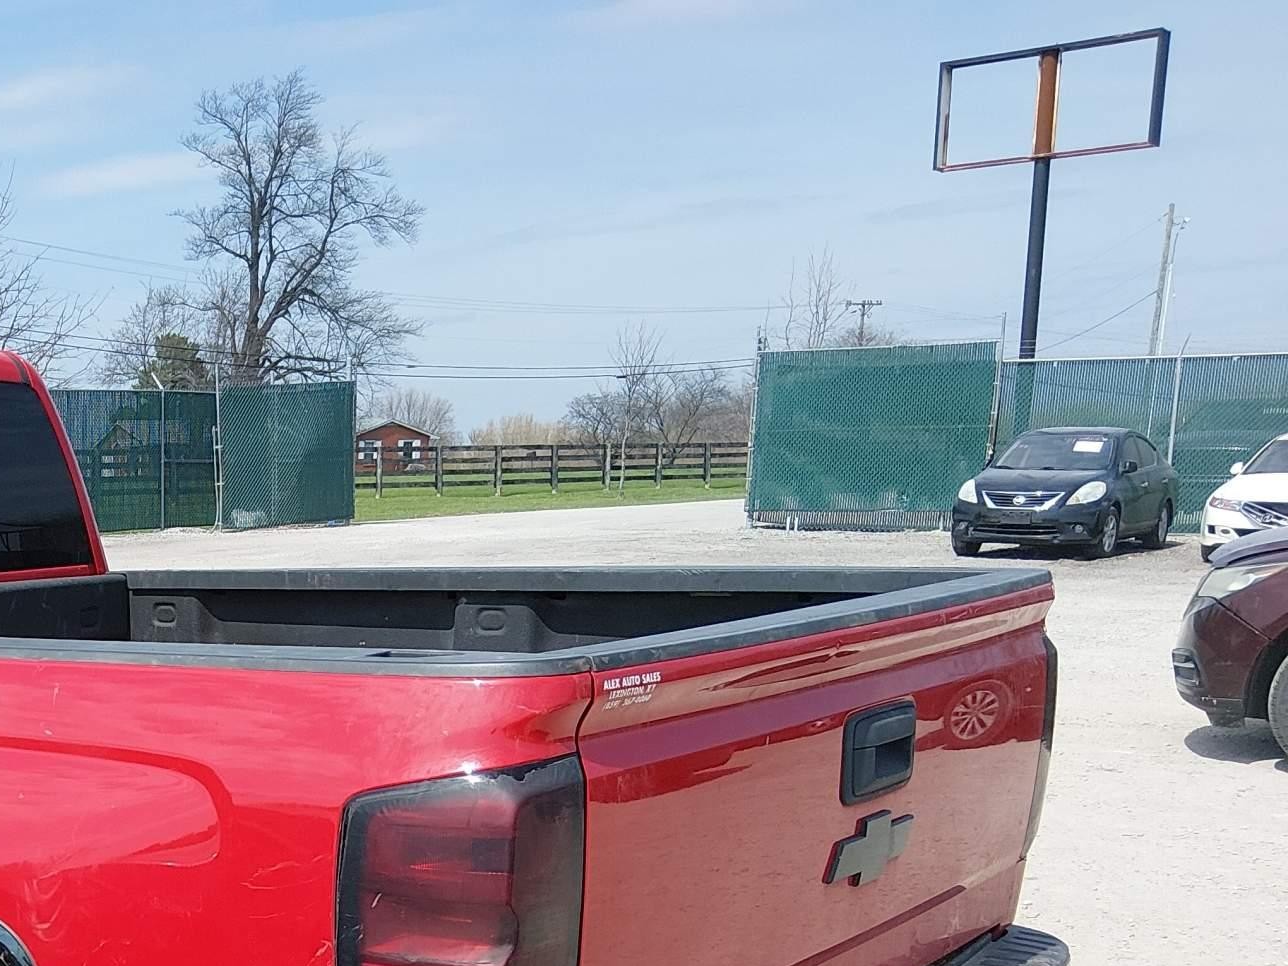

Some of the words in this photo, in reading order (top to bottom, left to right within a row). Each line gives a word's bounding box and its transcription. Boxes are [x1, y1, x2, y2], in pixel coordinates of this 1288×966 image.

[603, 678, 621, 690] ALEX
[622, 675, 641, 687] AUTO
[642, 672, 661, 684] SALES
